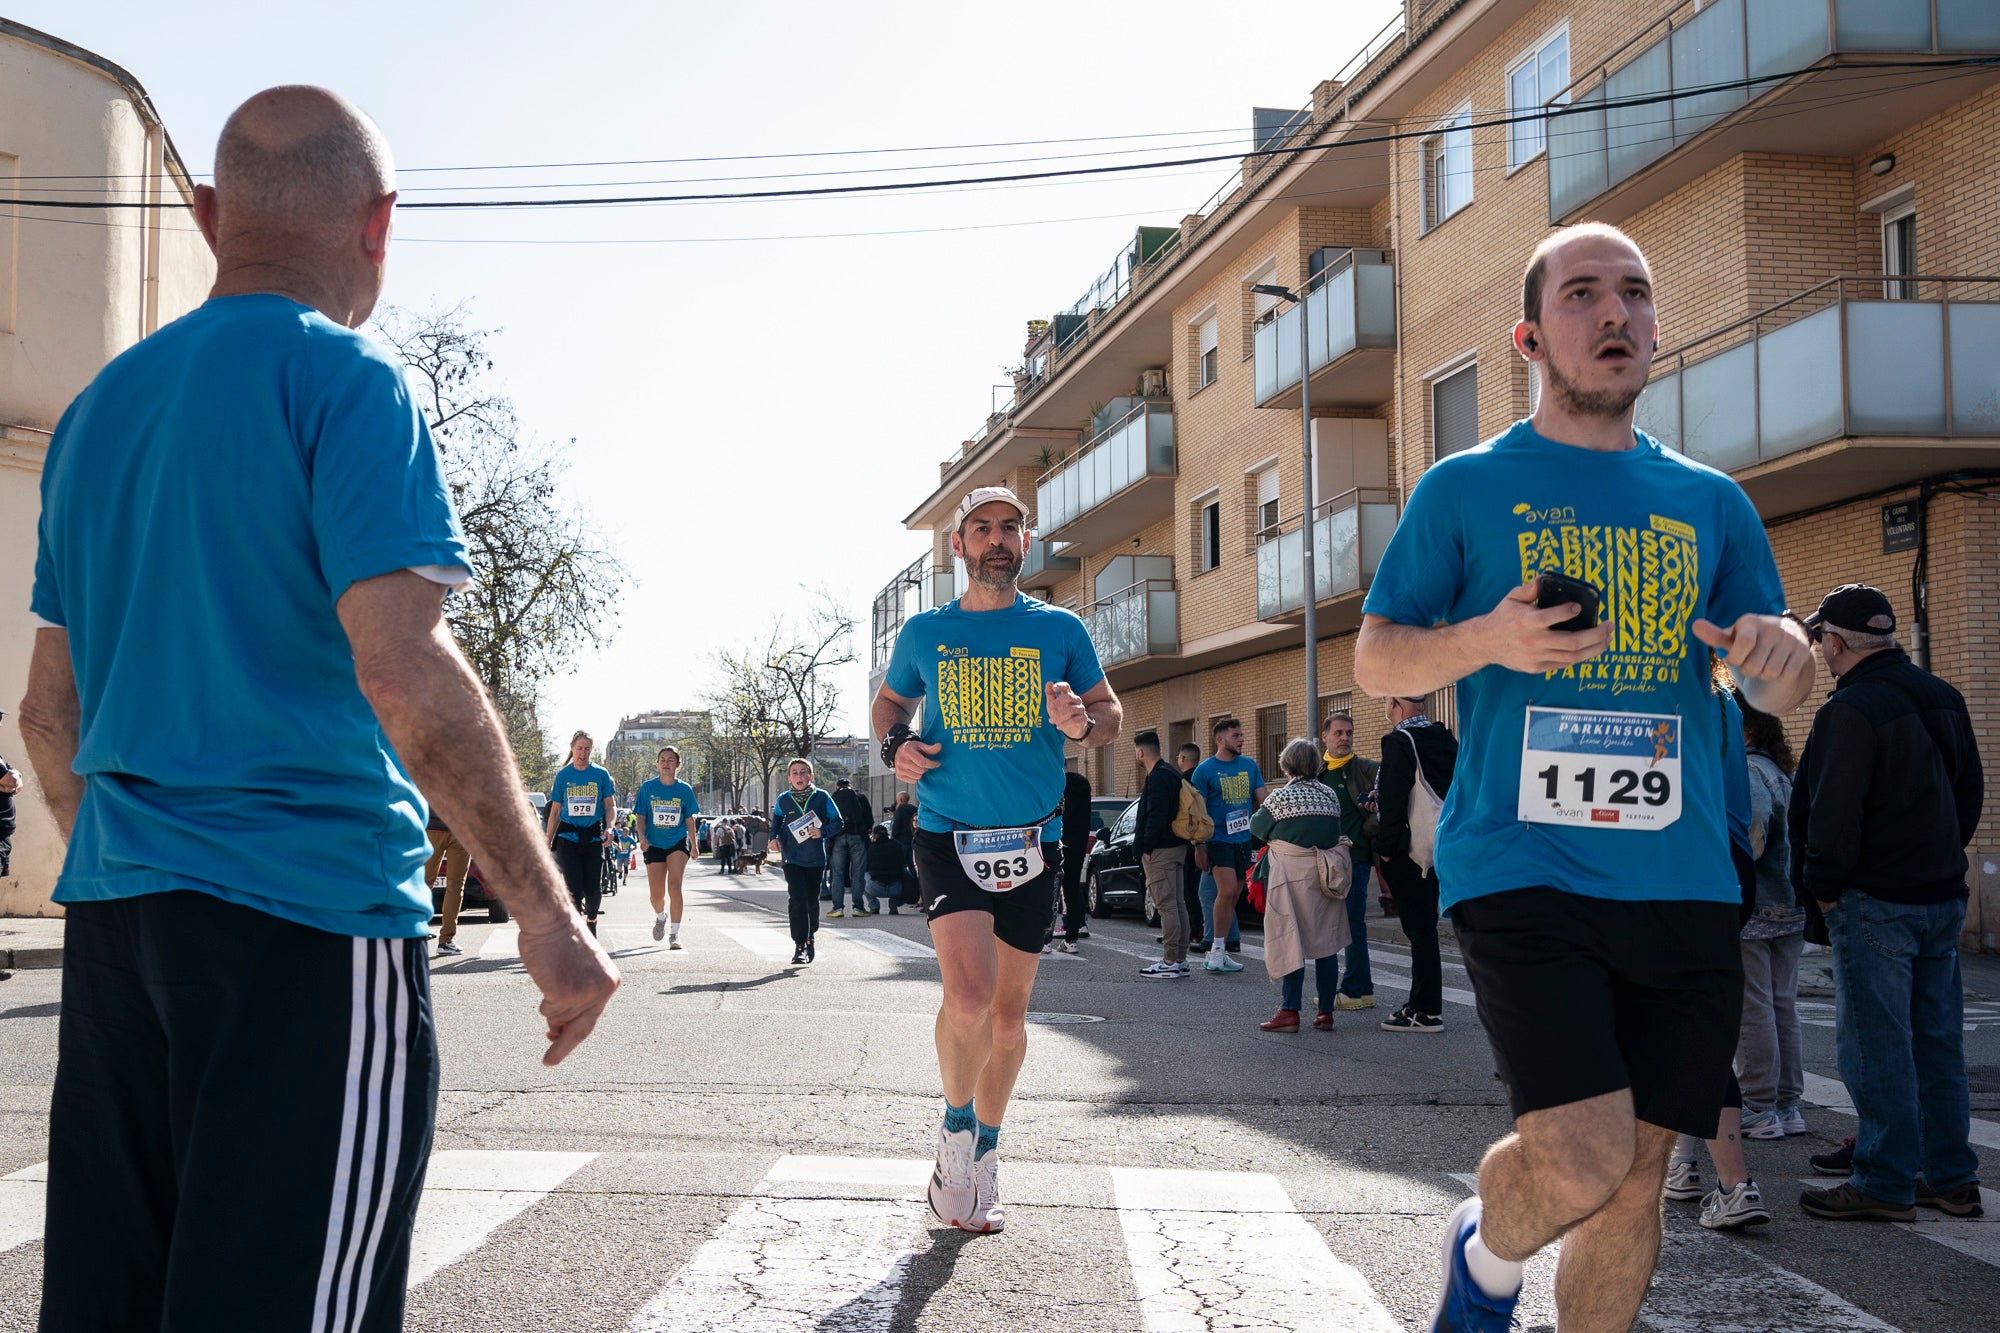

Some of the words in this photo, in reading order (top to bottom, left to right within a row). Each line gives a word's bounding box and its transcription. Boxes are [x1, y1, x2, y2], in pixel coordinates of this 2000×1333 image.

[1526, 506, 1575, 523] avan
[943, 647, 969, 656] avan
[1545, 663, 1680, 683] PARKINSON
[1559, 722, 1655, 738] PARKINSON
[953, 733, 1031, 744] PARKINSON
[1538, 764, 1671, 806] 1129
[658, 814, 676, 822] 979
[1556, 807, 1584, 818] avan
[1229, 819, 1248, 830] 1050
[973, 833, 1024, 844] PARKINSON
[974, 856, 1029, 880] 963
